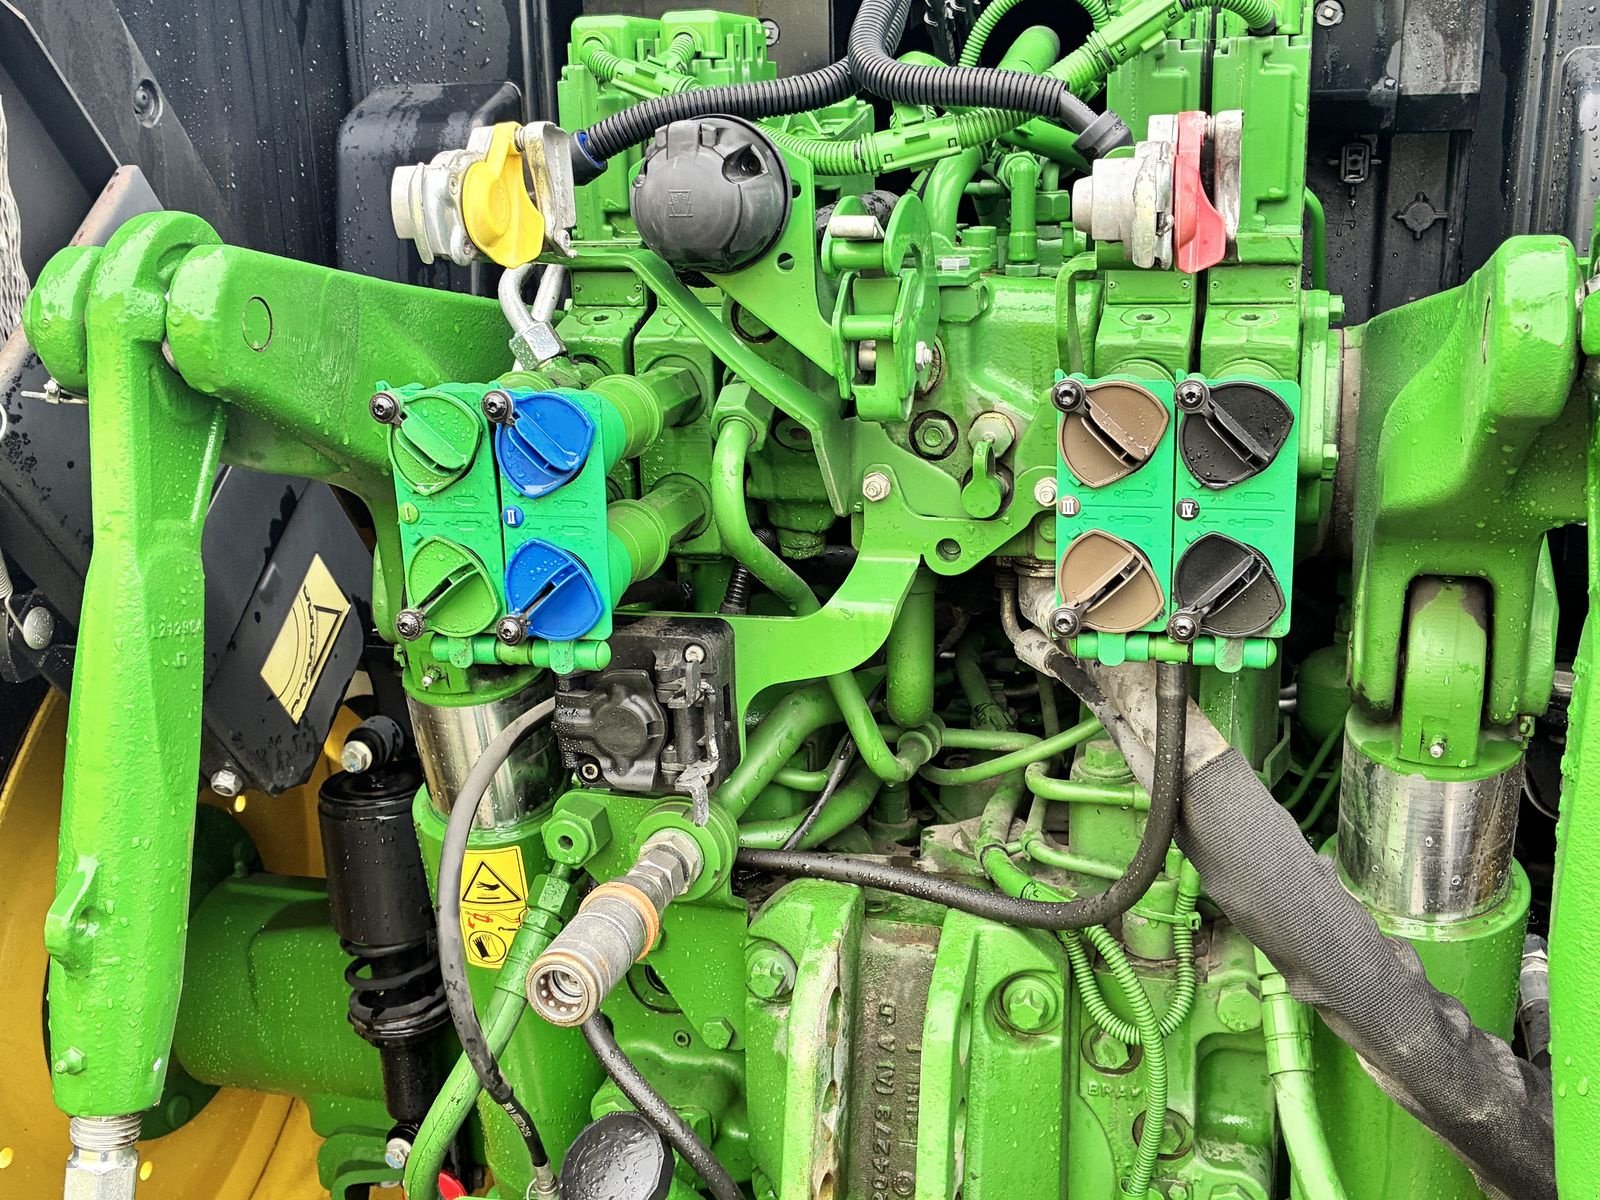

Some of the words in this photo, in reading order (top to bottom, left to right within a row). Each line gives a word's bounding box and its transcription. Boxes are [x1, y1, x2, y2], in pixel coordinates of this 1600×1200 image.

[1061, 499, 1075, 515] III
[1181, 502, 1194, 518] IV
[506, 509, 516, 525] II
